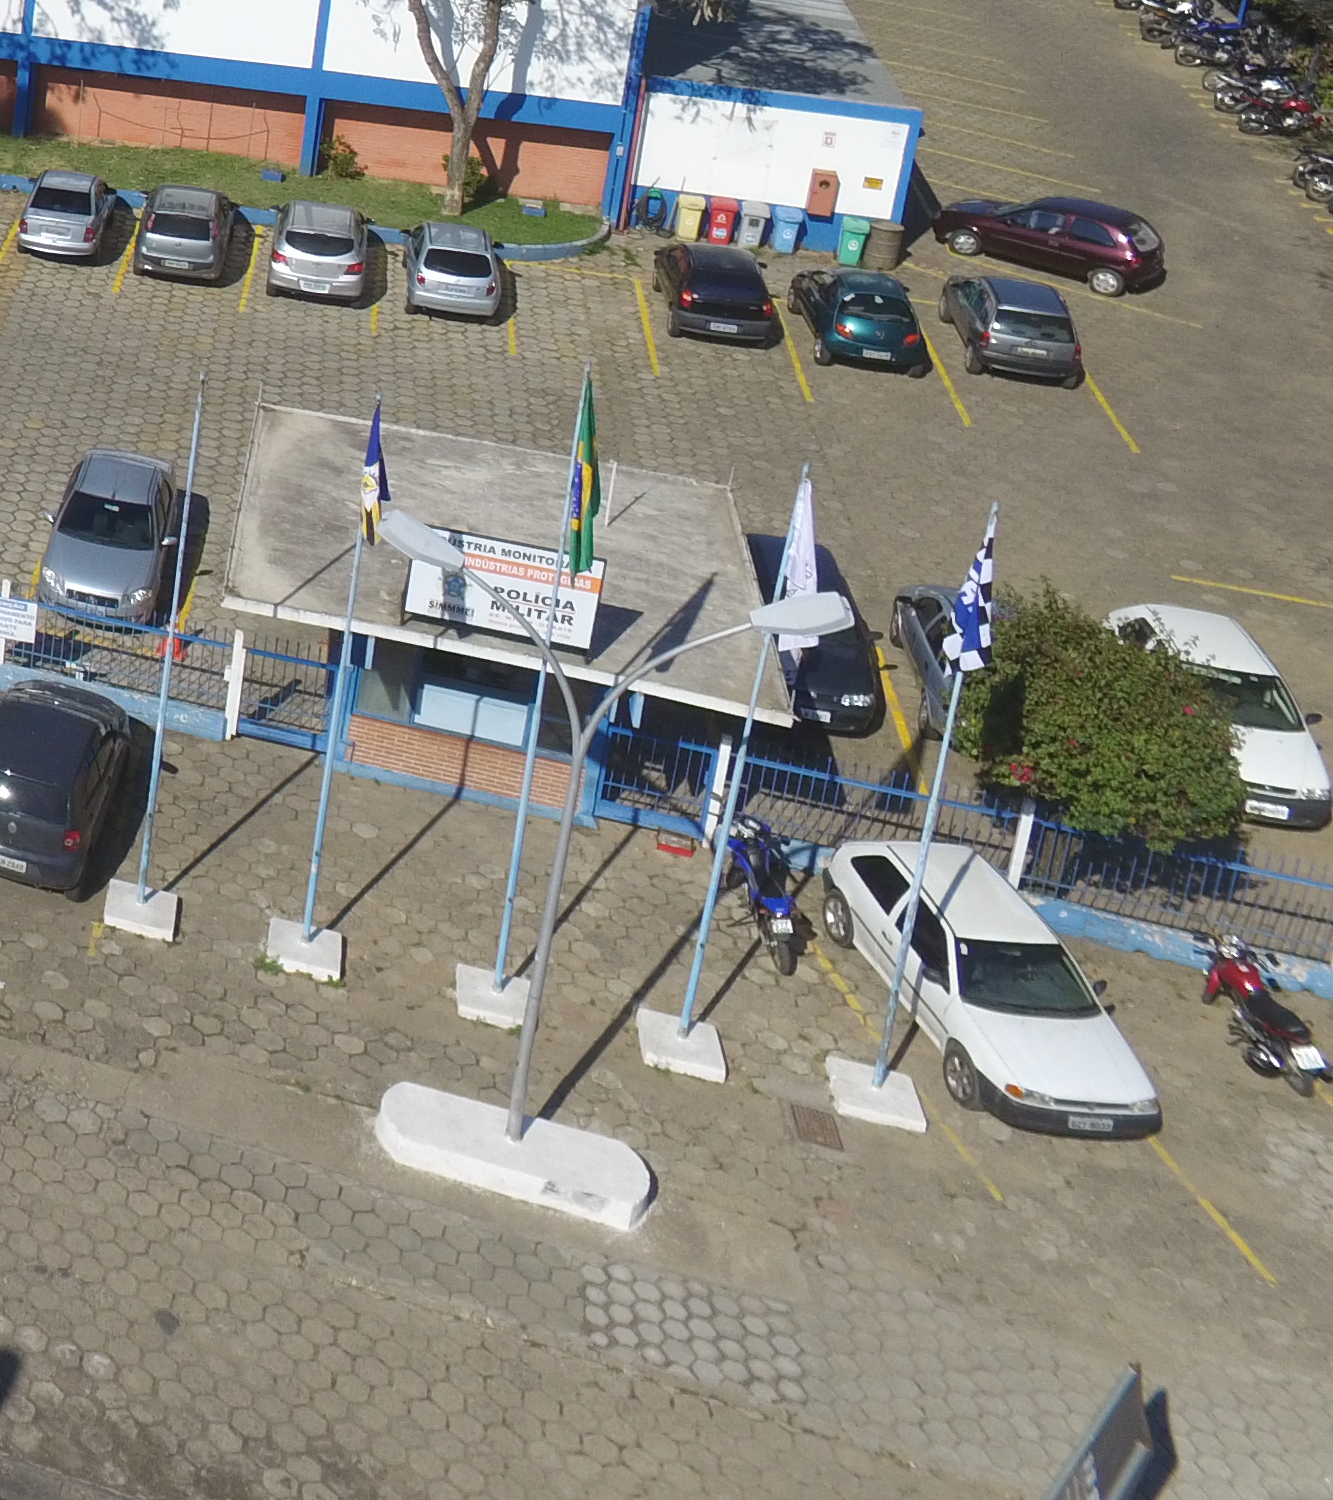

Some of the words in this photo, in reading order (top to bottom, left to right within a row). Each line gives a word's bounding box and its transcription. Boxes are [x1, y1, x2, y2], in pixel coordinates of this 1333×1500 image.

[464, 556, 526, 577] INDÚSTRIAS
[14, 618, 32, 627] PARA
[490, 600, 574, 626] MLITAR
